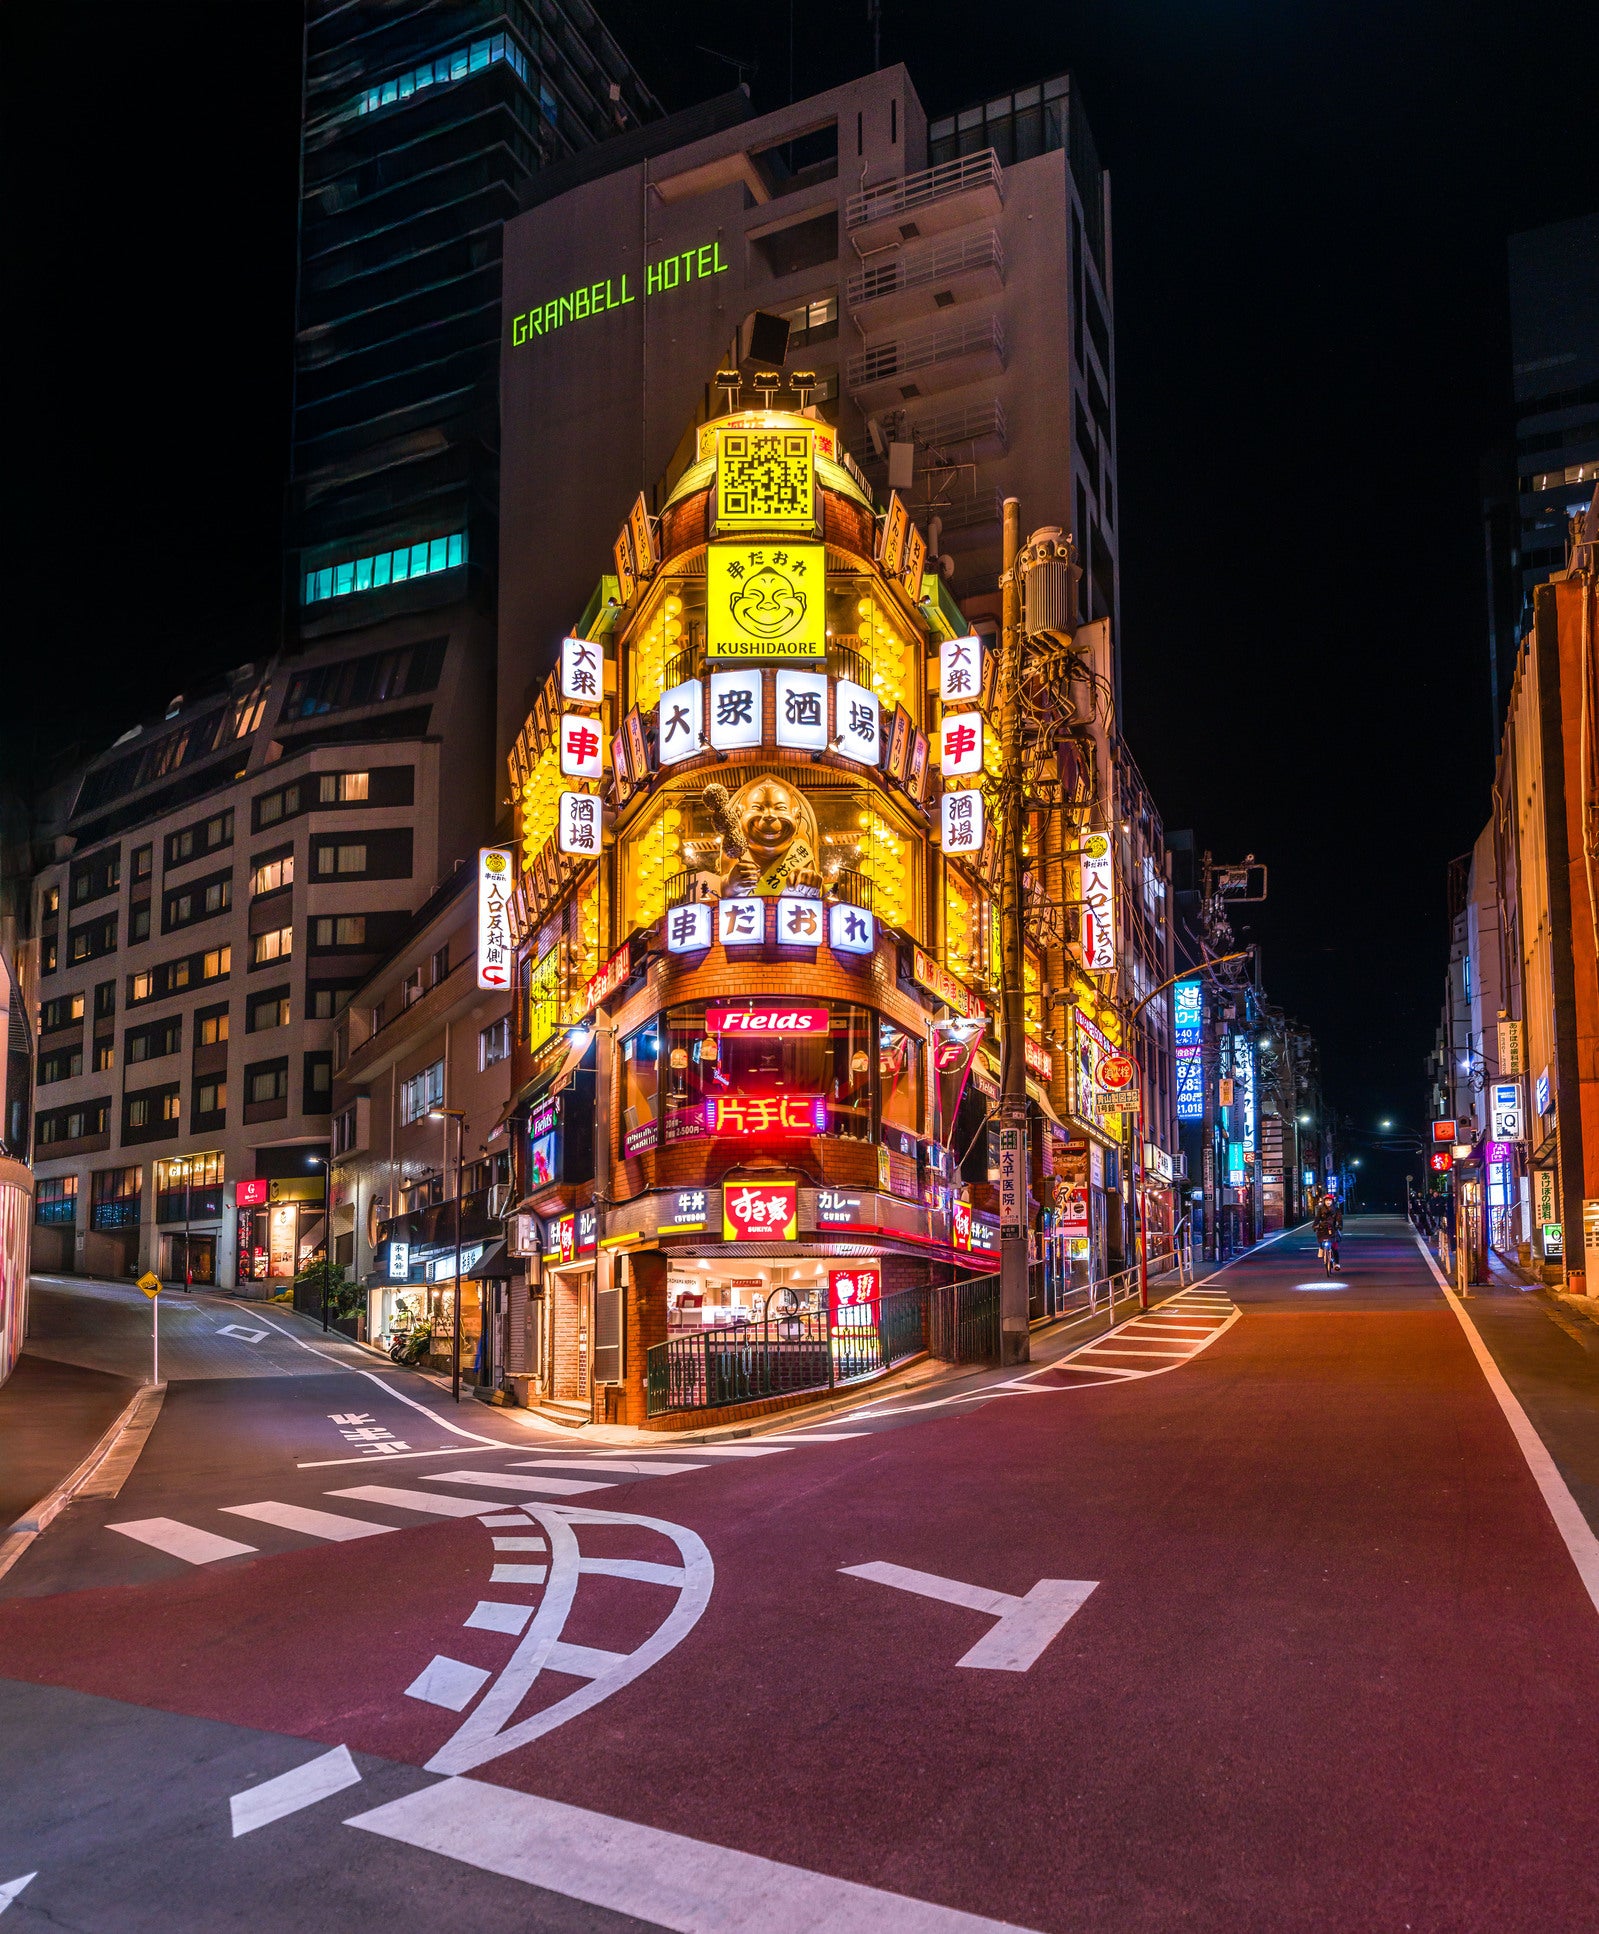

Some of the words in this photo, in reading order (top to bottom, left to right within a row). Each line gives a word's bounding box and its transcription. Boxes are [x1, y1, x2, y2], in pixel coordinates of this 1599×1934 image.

[513, 274, 635, 347] GRANBELL
[647, 242, 728, 295] HOTEL
[726, 551, 807, 580] 串だおれ
[716, 642, 817, 654] KUSHIDAORE
[571, 644, 597, 696] 大衆
[946, 644, 972, 694] 大衆
[664, 689, 875, 743] 大衆酒場
[566, 726, 600, 766] 串
[944, 724, 977, 765] 串
[569, 796, 596, 850] 酒場
[948, 794, 974, 848] 酒場
[765, 845, 810, 890] 串だおれ
[487, 883, 505, 965] 入口反対側
[671, 904, 870, 947] 串だおれ
[722, 1012, 813, 1030] Fields
[1509, 1022, 1519, 1076] あけぼの歯科医院
[1104, 1065, 1131, 1082] 消火栓
[716, 1098, 812, 1132] 片手に
[1504, 1114, 1516, 1128] Q
[247, 1183, 255, 1194] G
[1002, 1151, 1015, 1206] 太平医院
[1541, 1172, 1552, 1220] あけぼの歯科
[678, 1191, 705, 1212] 牛丼
[730, 1187, 788, 1226] すき家
[818, 1191, 861, 1210] カレー
[822, 1213, 851, 1222] CURRY
[580, 1213, 597, 1236] カレー
[747, 1226, 773, 1234] SUKIYA
[326, 1412, 412, 1455] 止まれ
